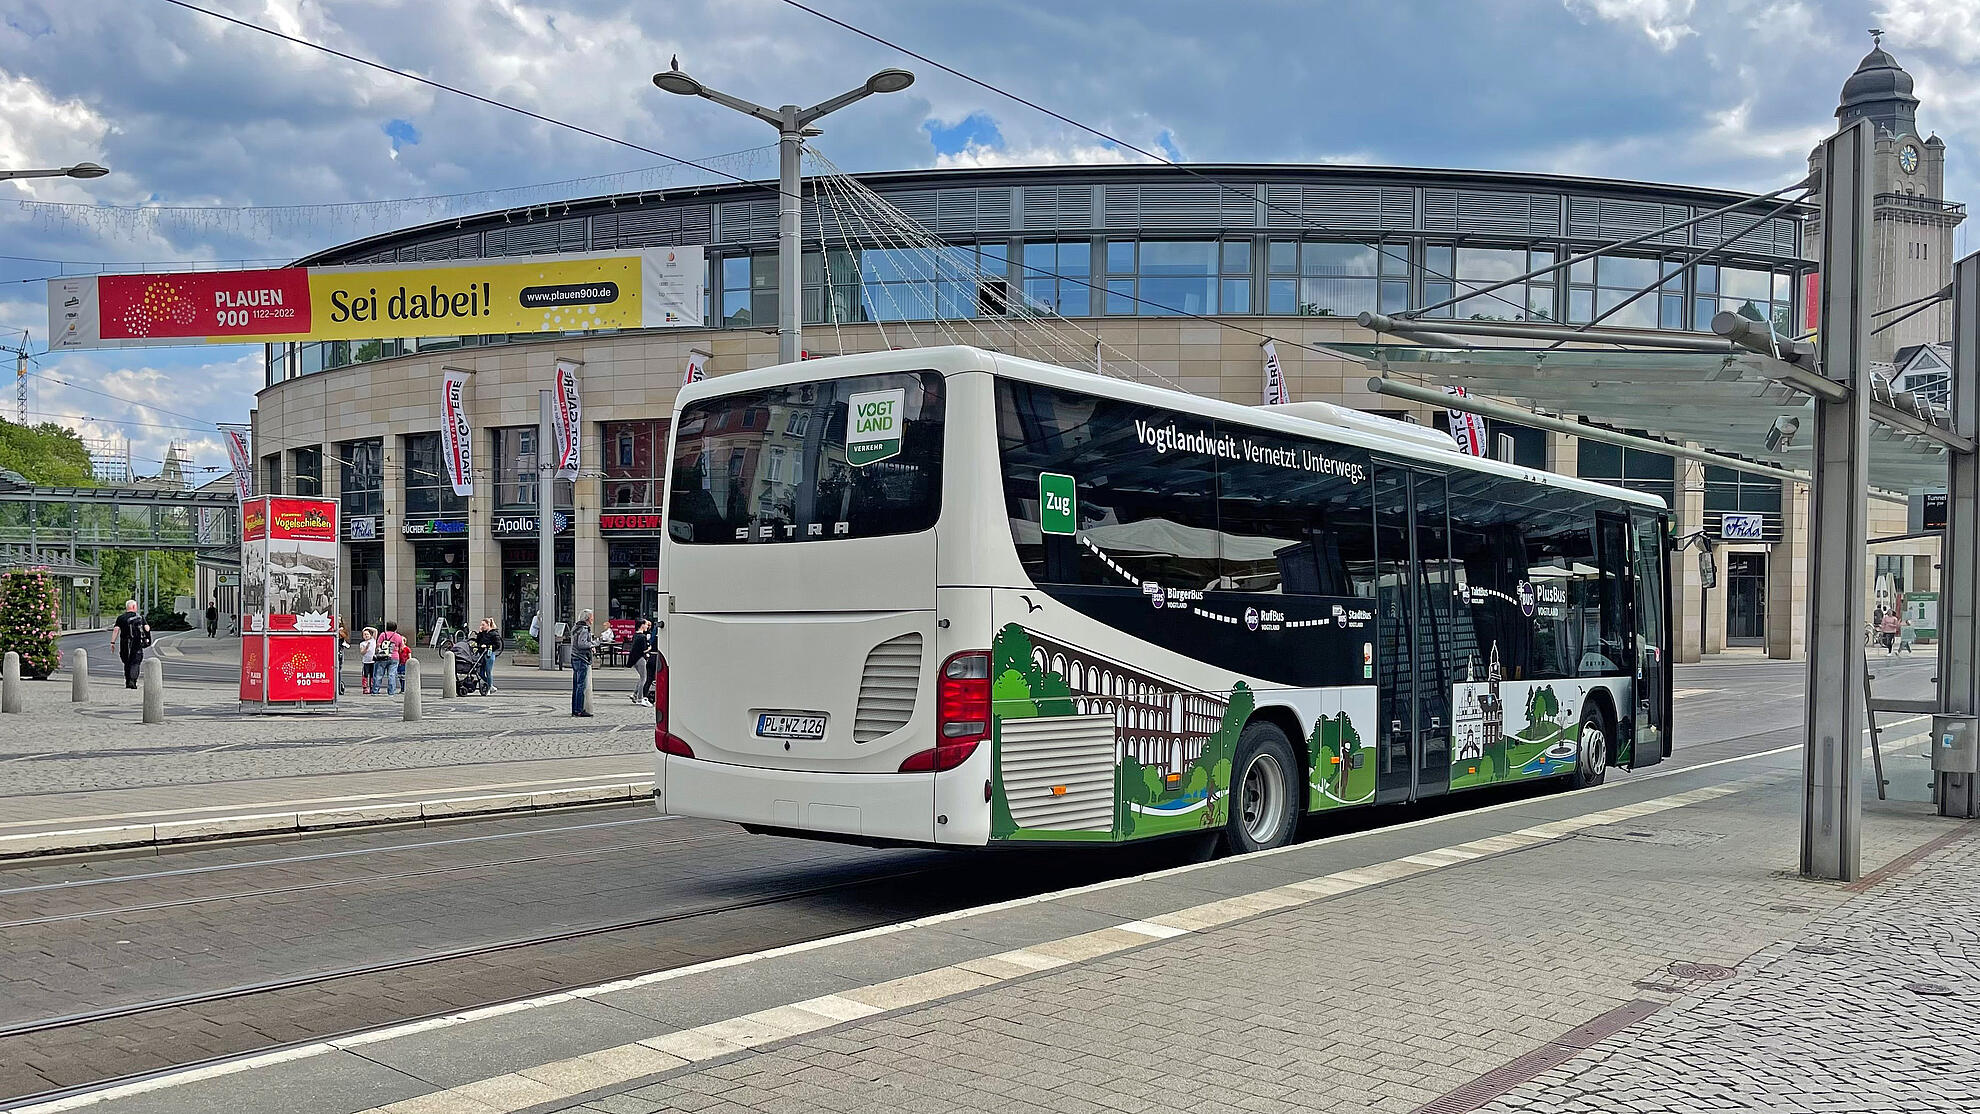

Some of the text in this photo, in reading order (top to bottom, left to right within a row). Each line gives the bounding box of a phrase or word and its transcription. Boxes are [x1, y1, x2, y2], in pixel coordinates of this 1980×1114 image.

[215, 289, 283, 308] PLAUEN
[330, 282, 491, 323] Sei dabei!
[526, 286, 611, 303] www.plauen900.de
[216, 310, 249, 327] 900
[857, 401, 895, 417] VOGT
[856, 416, 893, 433] LAND
[854, 444, 883, 452] VERKEHR
[1135, 420, 1366, 484] Vogtlandweit. Vernetzt. Unterwegs.
[1046, 492, 1070, 516] Zug
[275, 516, 332, 531] Vogelschießen
[497, 517, 533, 534] Apollo
[736, 521, 849, 539] SETRA
[1167, 587, 1204, 602] BürgerBus
[1536, 585, 1566, 603] PlusBus
[1260, 610, 1285, 622] RufBus
[1348, 609, 1372, 620] StadtBus
[296, 671, 326, 679] PLAUEN
[764, 717, 822, 734] PL WZ 126
